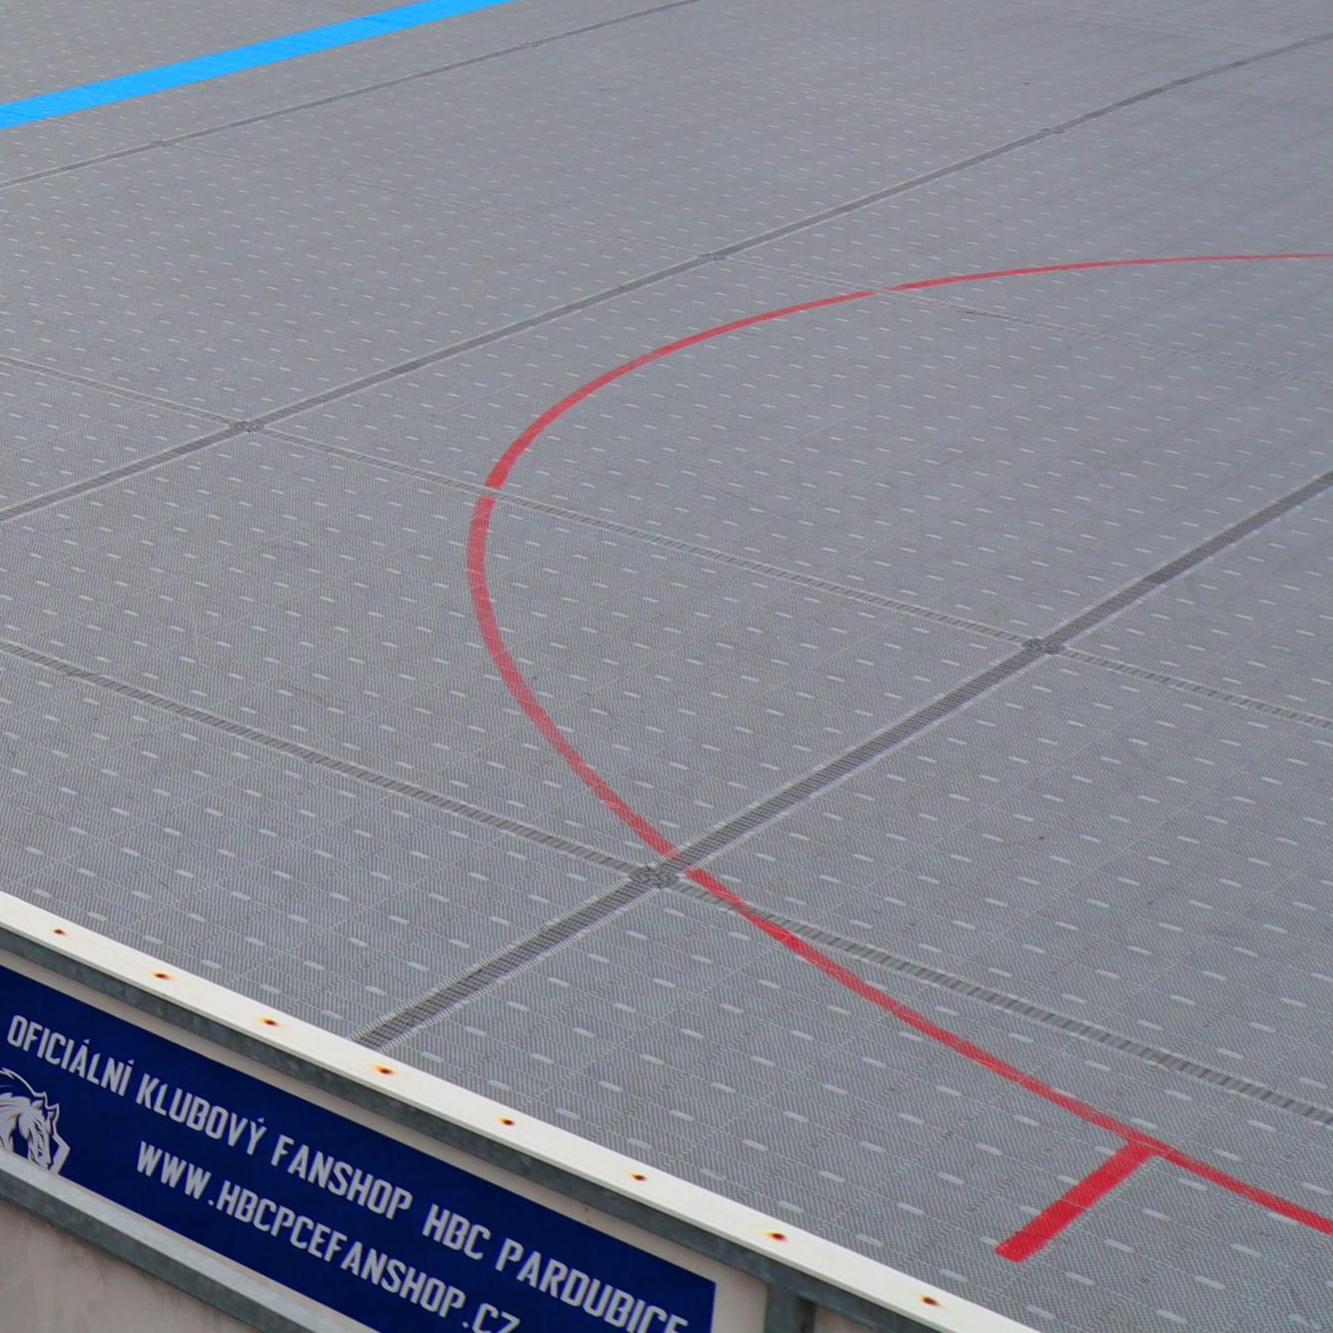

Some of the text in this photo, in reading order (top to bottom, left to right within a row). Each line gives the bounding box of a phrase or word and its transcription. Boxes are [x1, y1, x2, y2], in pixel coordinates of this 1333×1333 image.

[6, 1014, 135, 1097] OFICIÁLNÍ
[135, 1072, 268, 1156] KLUBOVÝ
[270, 1133, 414, 1220] FANSHOP
[421, 1202, 492, 1261] HBC
